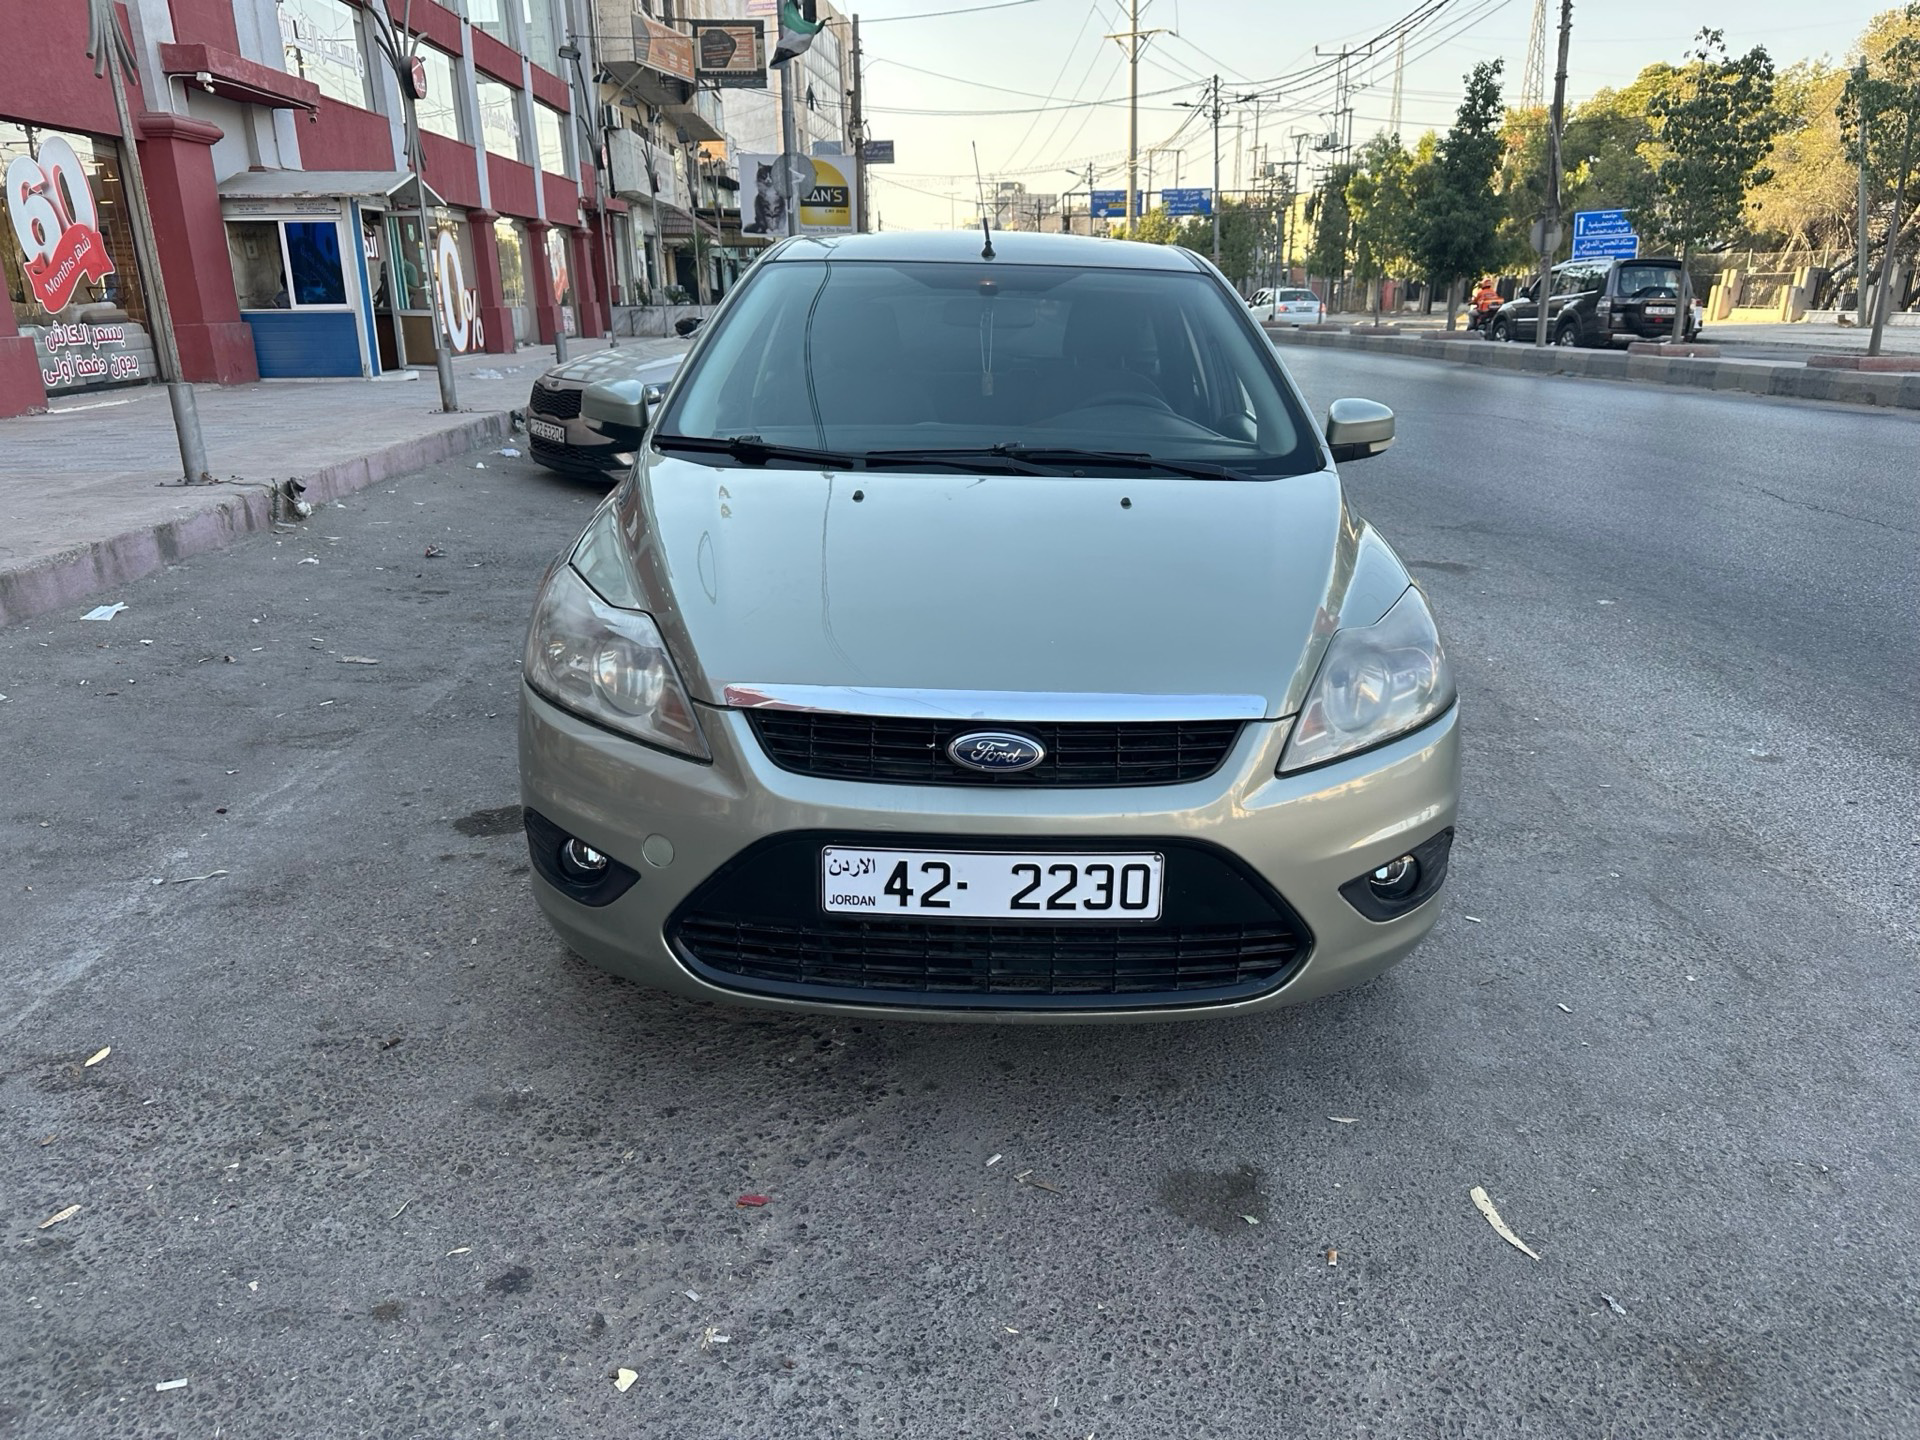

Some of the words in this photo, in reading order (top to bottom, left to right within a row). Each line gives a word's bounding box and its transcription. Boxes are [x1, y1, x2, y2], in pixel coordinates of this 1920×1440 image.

[6, 135, 98, 265] 60
[803, 188, 843, 203] AN'S
[74, 233, 91, 264] شهر
[44, 256, 76, 296] Months
[45, 320, 91, 353] الكاش
[92, 326, 126, 350] بسعر
[43, 351, 75, 386] أولى
[76, 353, 108, 377] دفعة
[111, 353, 140, 379] بدون
[970, 740, 1021, 763] Ford
[828, 857, 877, 876] الاردن
[1010, 862, 1152, 911] 2230
[829, 894, 876, 907] JORDAN
